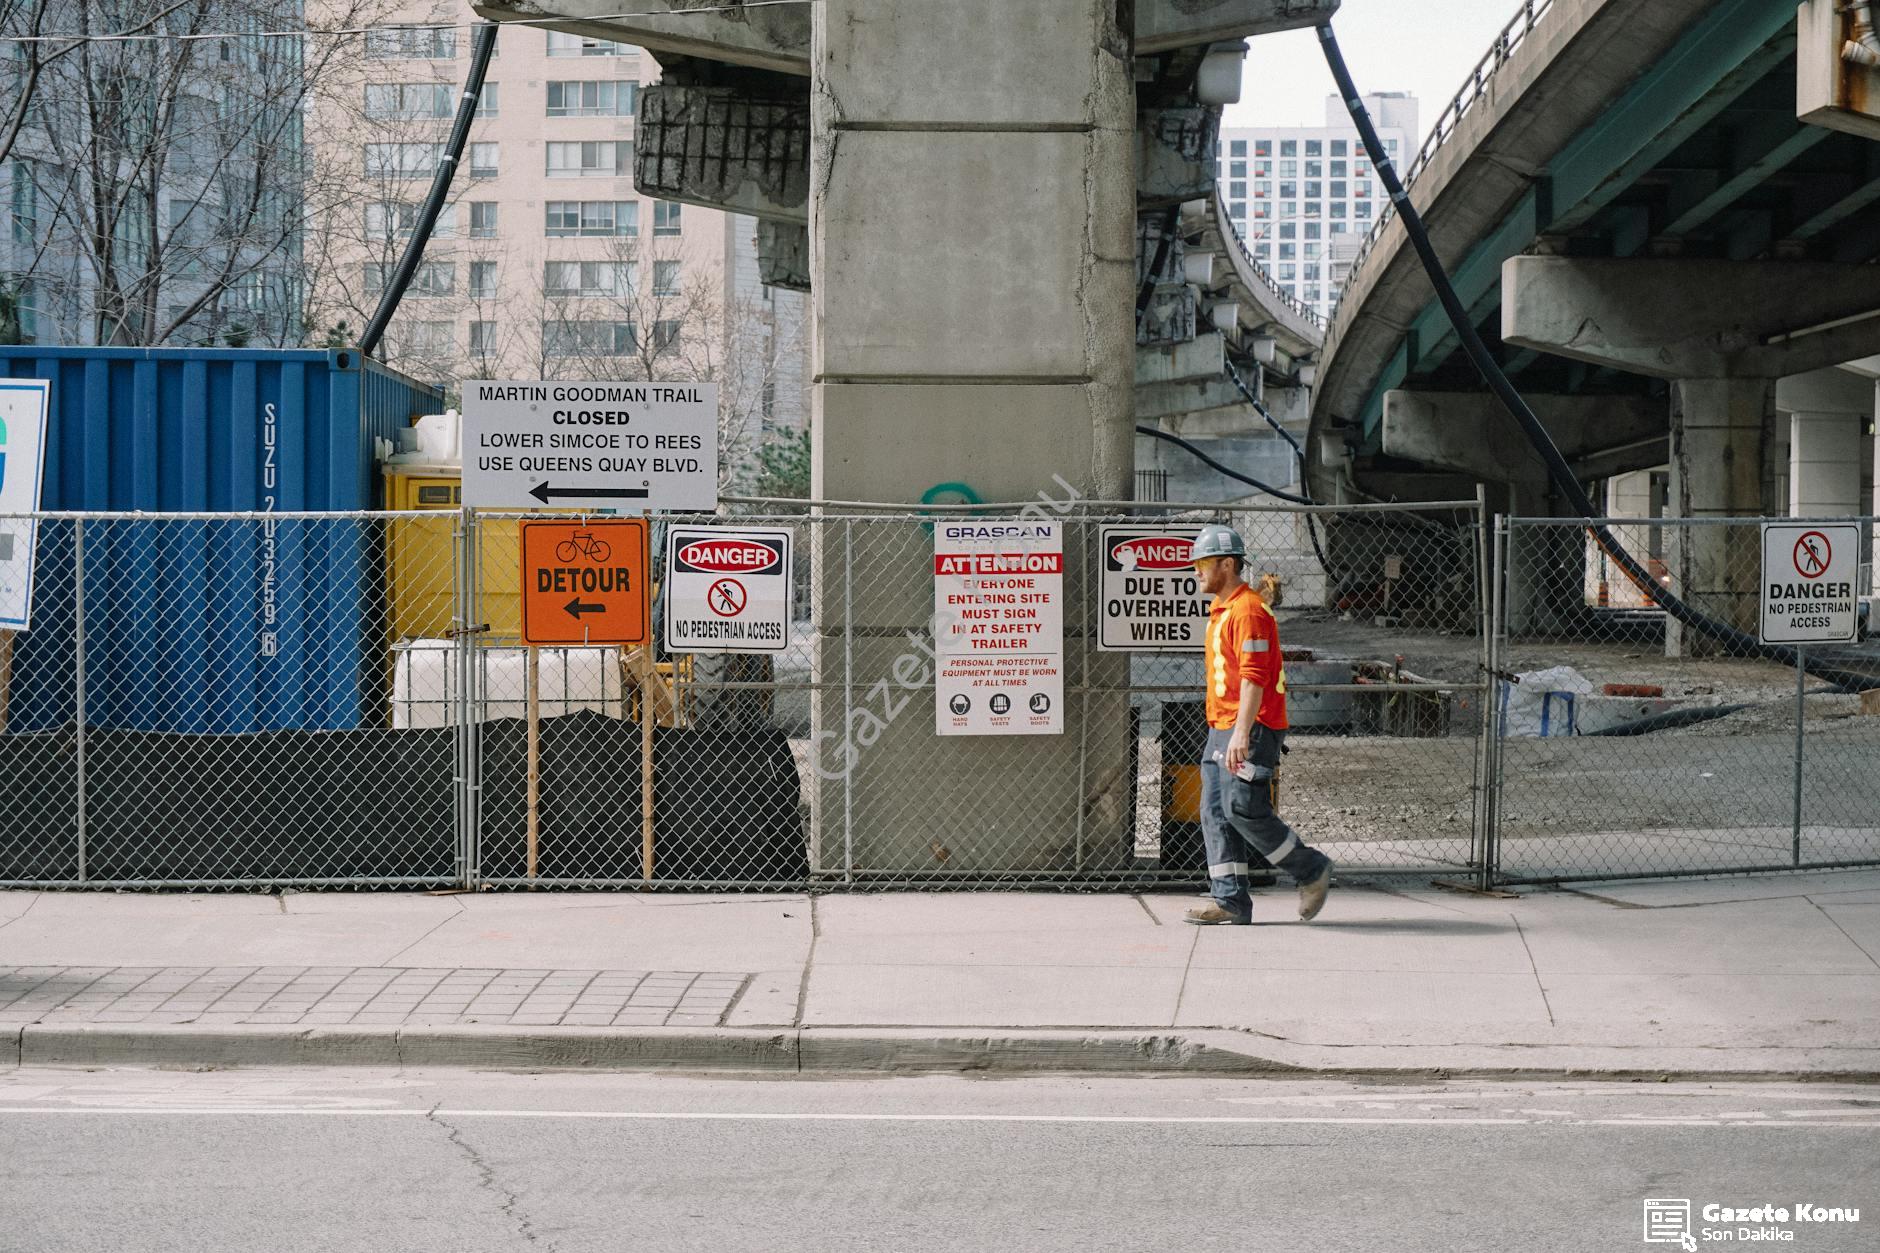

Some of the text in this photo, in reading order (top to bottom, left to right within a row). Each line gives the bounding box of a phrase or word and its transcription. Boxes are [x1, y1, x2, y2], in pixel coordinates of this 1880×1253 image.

[479, 386, 702, 403] MARTIN GOODMAN TRAIL
[553, 411, 630, 425] CLOSED
[264, 403, 276, 489] SUZU
[480, 433, 701, 450] LOWER SIMCOE TO REES
[478, 456, 703, 473] USE QUEENS QUAY BLVD.
[946, 526, 1051, 538] GRASCAN
[264, 495, 275, 625] 203259
[687, 547, 769, 565] DANGER
[941, 556, 1057, 572] ATTENTION
[537, 568, 630, 593] DETOUR
[964, 579, 1035, 589] EVERYONE
[1125, 578, 1197, 595] DUE TO
[948, 593, 1050, 605] ENTERING SITE
[1770, 583, 1851, 599] DANGER
[962, 609, 1036, 619] MUST SIGN
[1108, 599, 1211, 617] OVERHEAD
[1769, 602, 1851, 614] NO PEDESTRIAN
[676, 620, 781, 640] NO PEDESTRIAN ACCESS
[952, 623, 1042, 634] IN AT SAFETY
[1790, 617, 1831, 628] ACCESS
[1131, 623, 1191, 640] WIRES
[971, 639, 1028, 649] TRAILER
[997, 658, 1049, 666] PROTECTIVE
